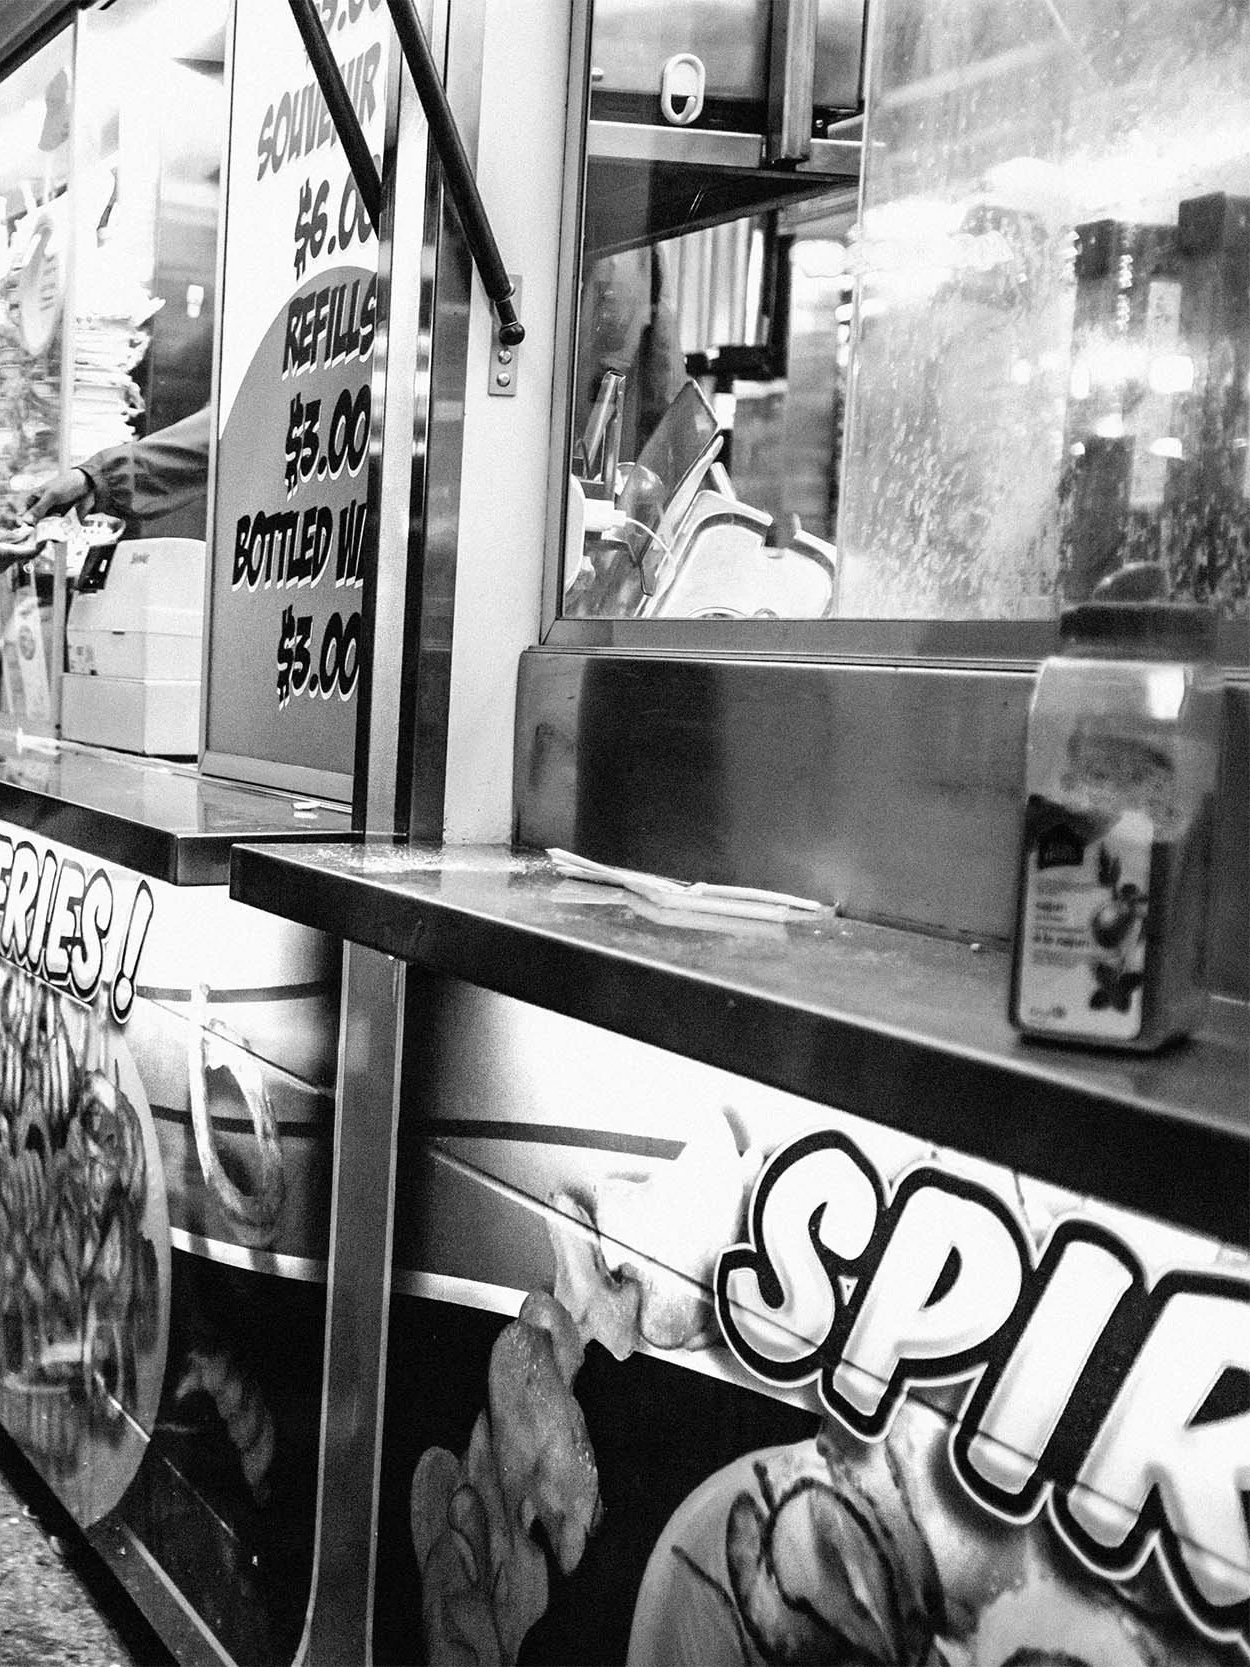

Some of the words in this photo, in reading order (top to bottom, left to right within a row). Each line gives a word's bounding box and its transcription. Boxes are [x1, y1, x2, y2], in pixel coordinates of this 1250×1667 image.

[282, 272, 377, 381] REFILLS
[285, 385, 371, 500] $3.00
[232, 506, 333, 592] BOTTLED
[277, 604, 361, 711] $3.00
